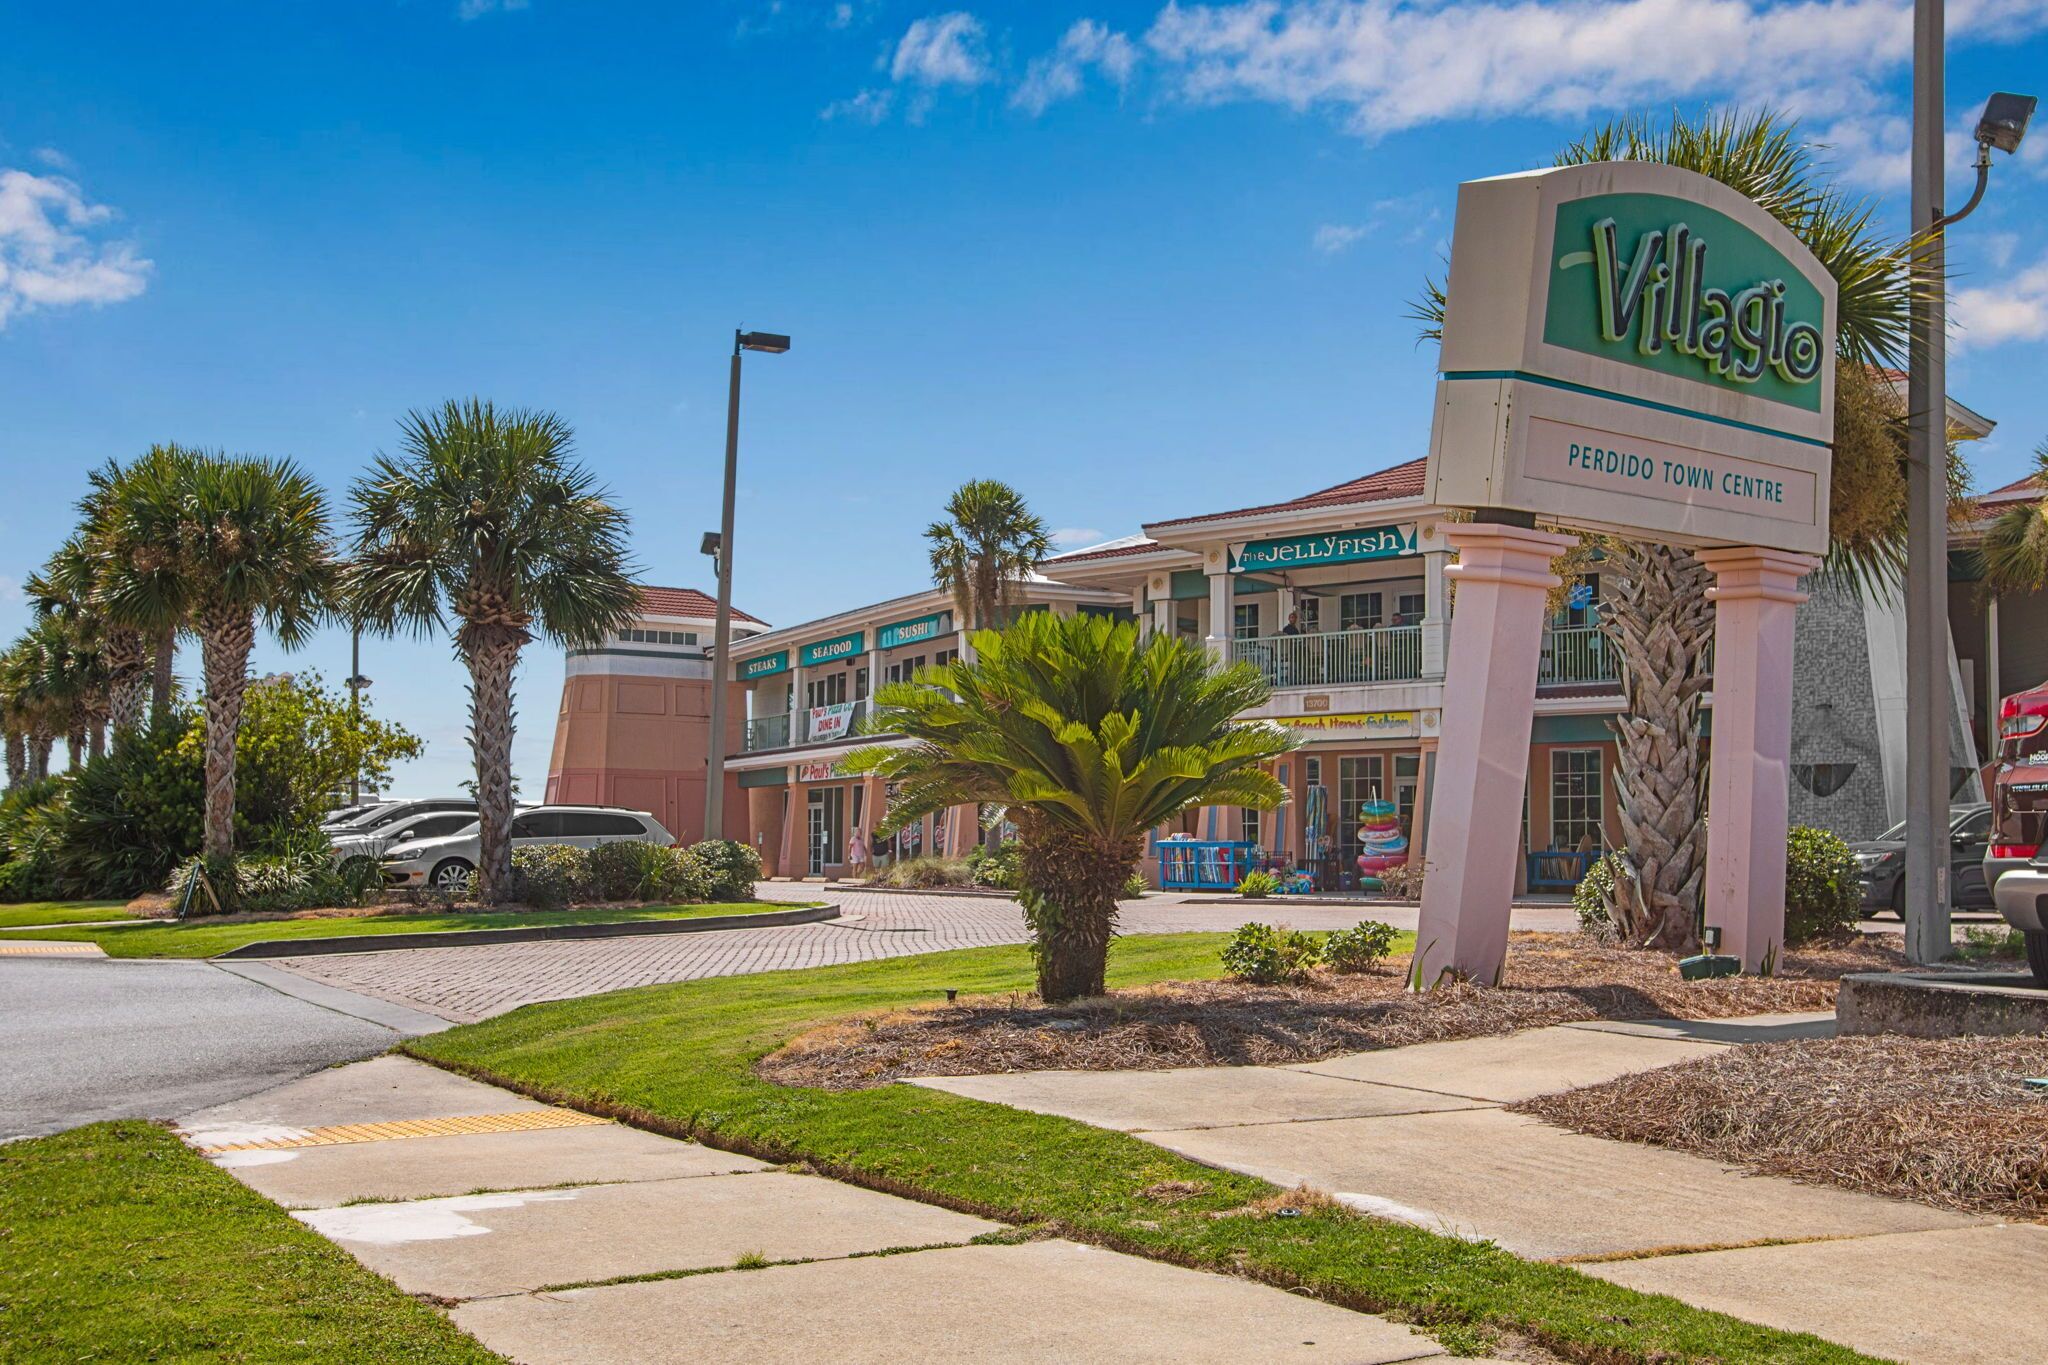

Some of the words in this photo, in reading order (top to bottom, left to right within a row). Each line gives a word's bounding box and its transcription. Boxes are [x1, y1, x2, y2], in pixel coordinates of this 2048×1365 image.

[1593, 217, 1823, 383] Villagio
[1568, 444, 1654, 480] PERDIDO
[1663, 461, 1713, 491] TOWN
[1722, 472, 1783, 503] CENTRE
[899, 622, 929, 640] SUSHI
[812, 640, 852, 660] SEAFOOD
[748, 657, 777, 674] STEAKS
[1305, 700, 1328, 709] 13700
[818, 717, 833, 732] DINE
[834, 716, 842, 729] IN
[1293, 718, 1326, 731] Beach
[810, 763, 829, 780] Paul's
